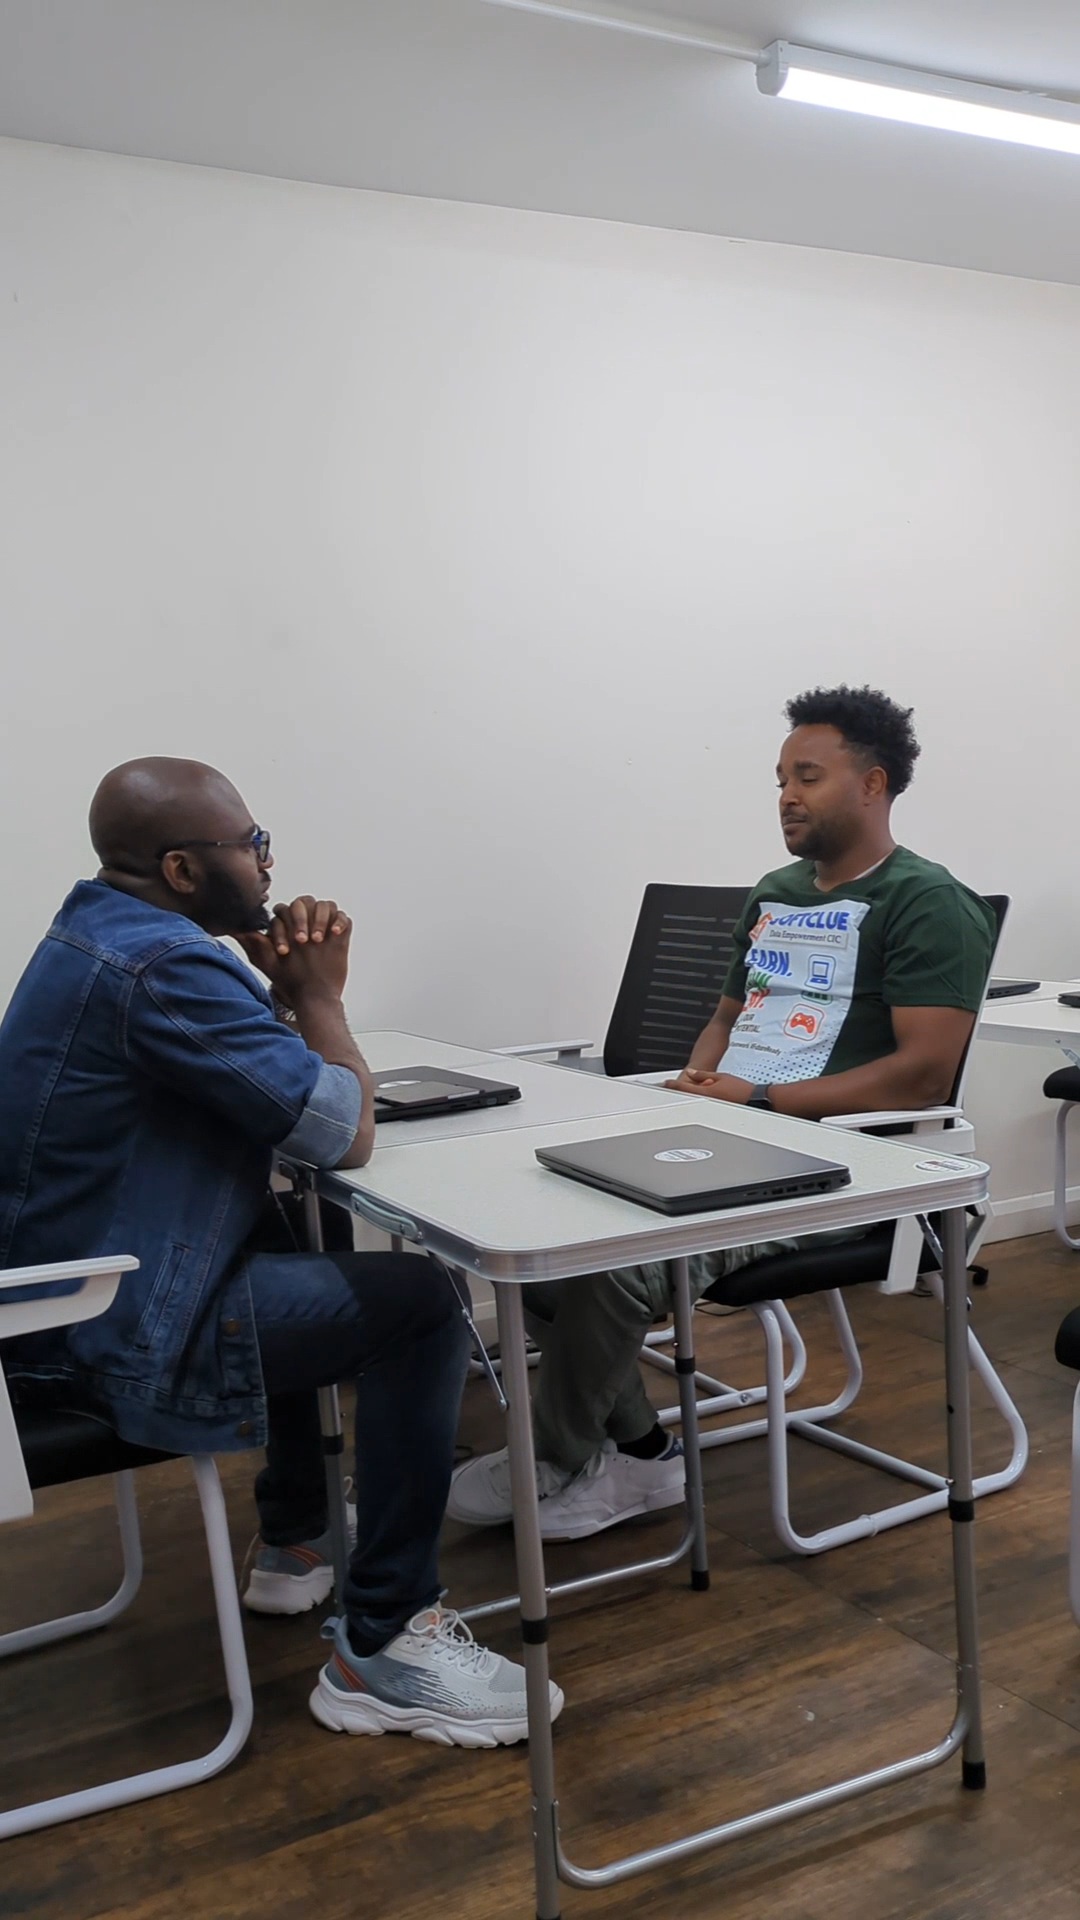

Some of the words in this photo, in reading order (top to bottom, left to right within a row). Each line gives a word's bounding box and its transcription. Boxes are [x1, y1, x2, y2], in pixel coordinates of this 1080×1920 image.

[769, 929, 782, 938] Data
[782, 930, 826, 941] Empowerment
[827, 934, 842, 944] CIC
[748, 948, 792, 976] EARN.
